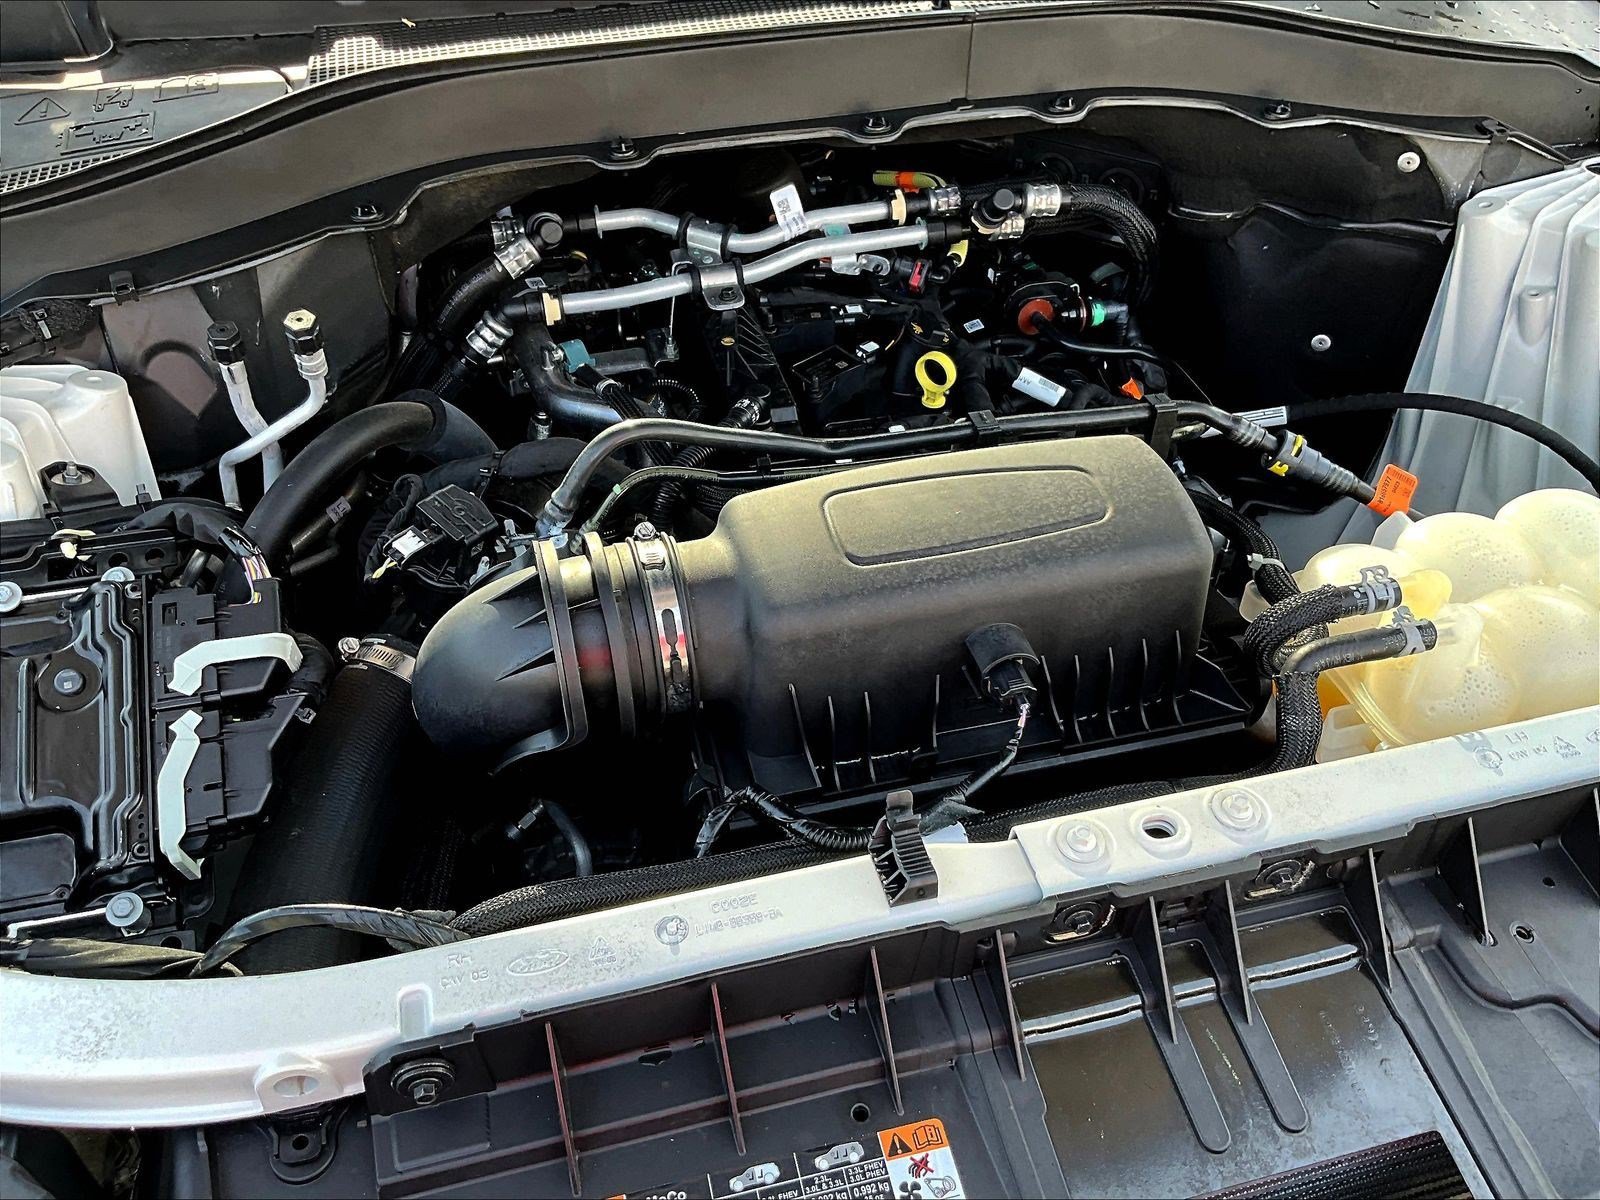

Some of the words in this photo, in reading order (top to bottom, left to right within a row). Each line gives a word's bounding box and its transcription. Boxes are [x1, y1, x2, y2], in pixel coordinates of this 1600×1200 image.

[1504, 730, 1529, 745] LH
[447, 953, 473, 969] RH
[848, 1166, 863, 1176] 3.3L
[863, 1160, 883, 1172] FHEV
[850, 1173, 866, 1183] 3.0L
[866, 1168, 886, 1179] PHEV
[778, 1189, 798, 1200] FHEV
[805, 1185, 820, 1194] 3.0L
[821, 1182, 828, 1190] &
[853, 1184, 877, 1197] 0.992
[877, 1181, 890, 1192] kg
